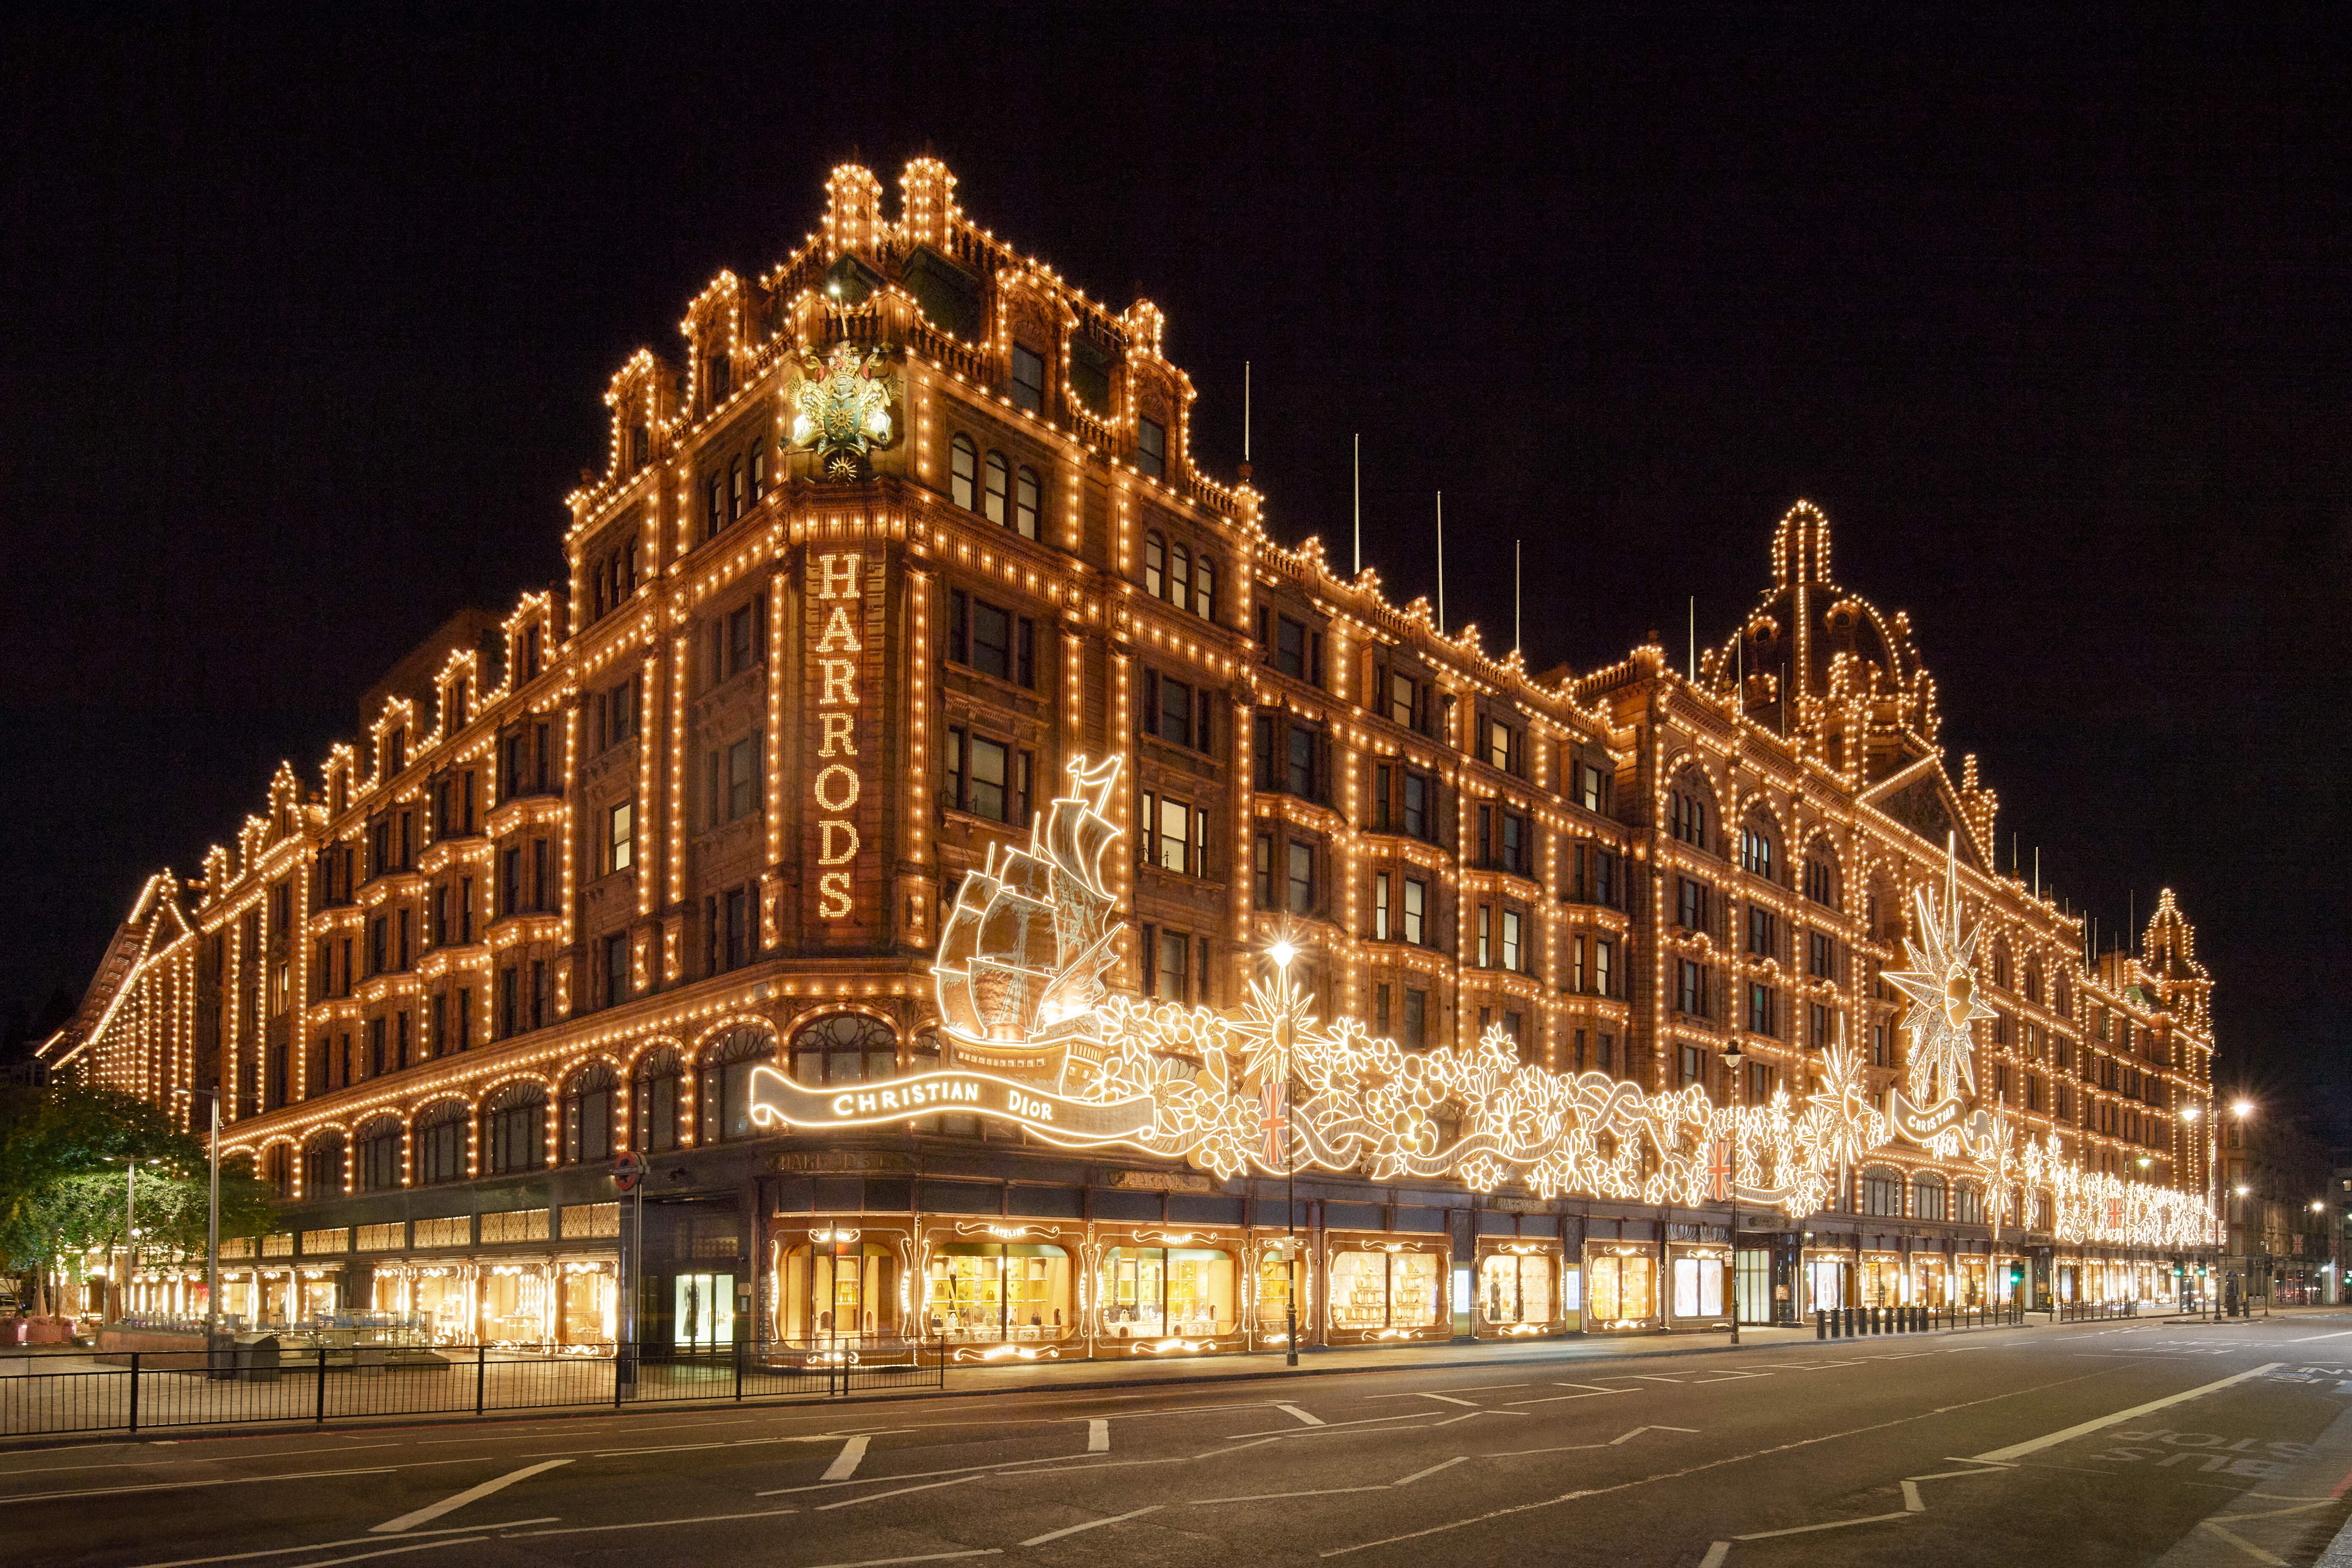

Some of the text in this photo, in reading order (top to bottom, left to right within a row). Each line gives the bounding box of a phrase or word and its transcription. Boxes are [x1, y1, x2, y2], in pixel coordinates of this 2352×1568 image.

[815, 553, 862, 918] HARRODS
[833, 1081, 1053, 1121] CHRISTIAN DIOR
[1908, 1104, 1955, 1132] CHRISTIAN
